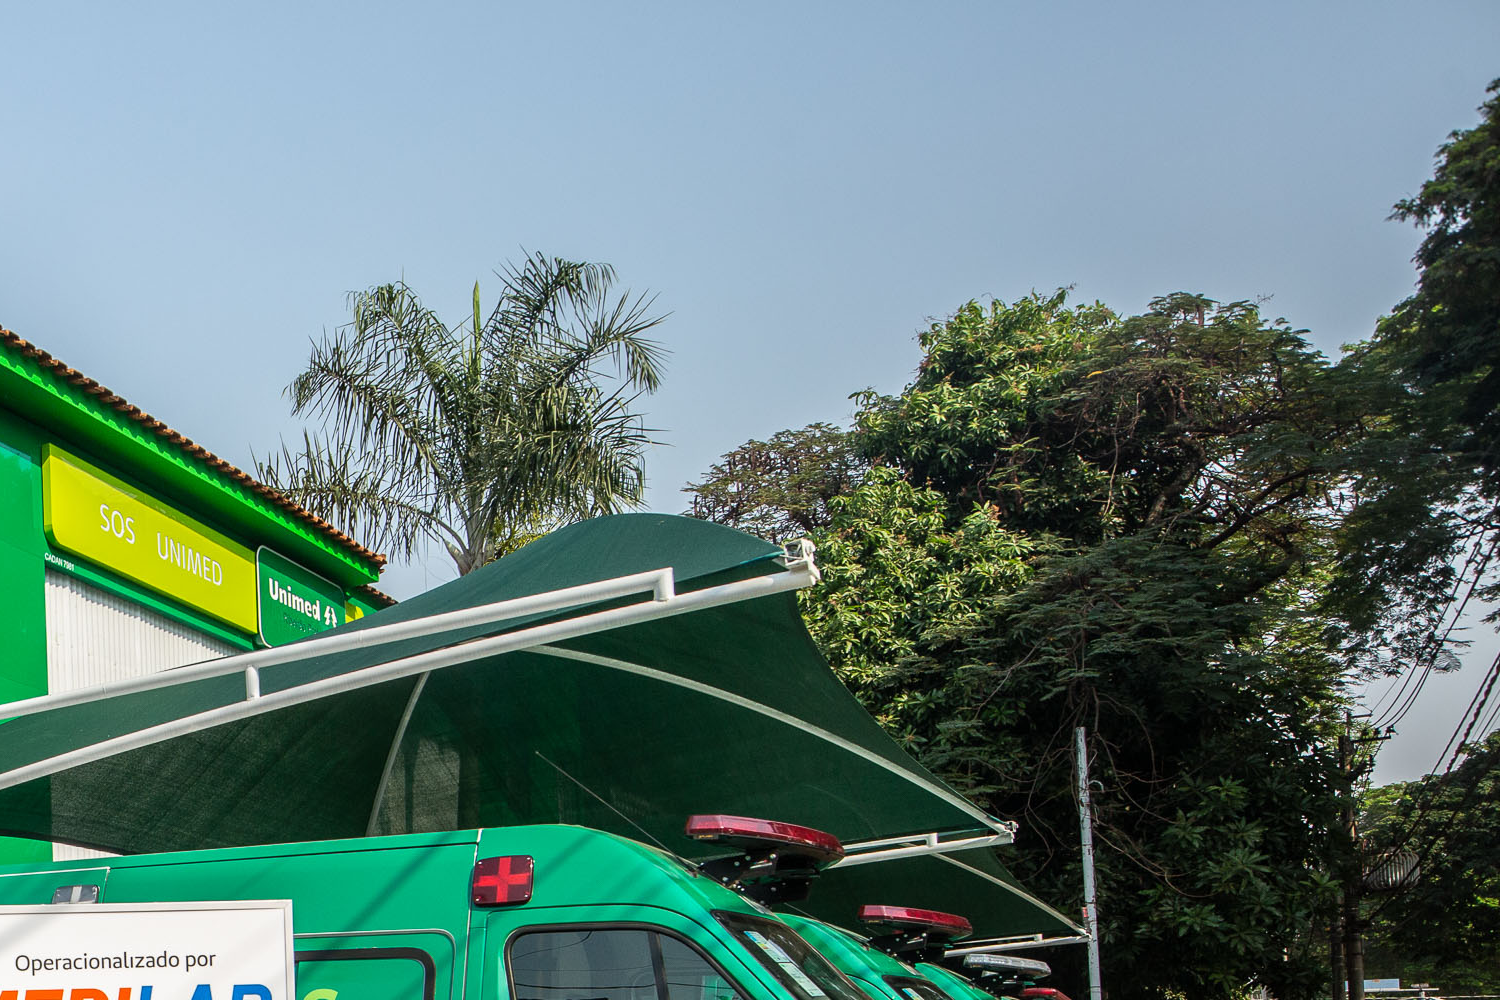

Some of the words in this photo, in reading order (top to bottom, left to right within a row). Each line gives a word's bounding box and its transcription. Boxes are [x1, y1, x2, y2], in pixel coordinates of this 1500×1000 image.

[44, 552, 63, 567] CADAN
[100, 504, 136, 544] SOS
[157, 532, 224, 586] UNIMED
[268, 577, 321, 622] Unimed
[14, 950, 180, 976] Operacionalizado
[185, 953, 216, 973] por
